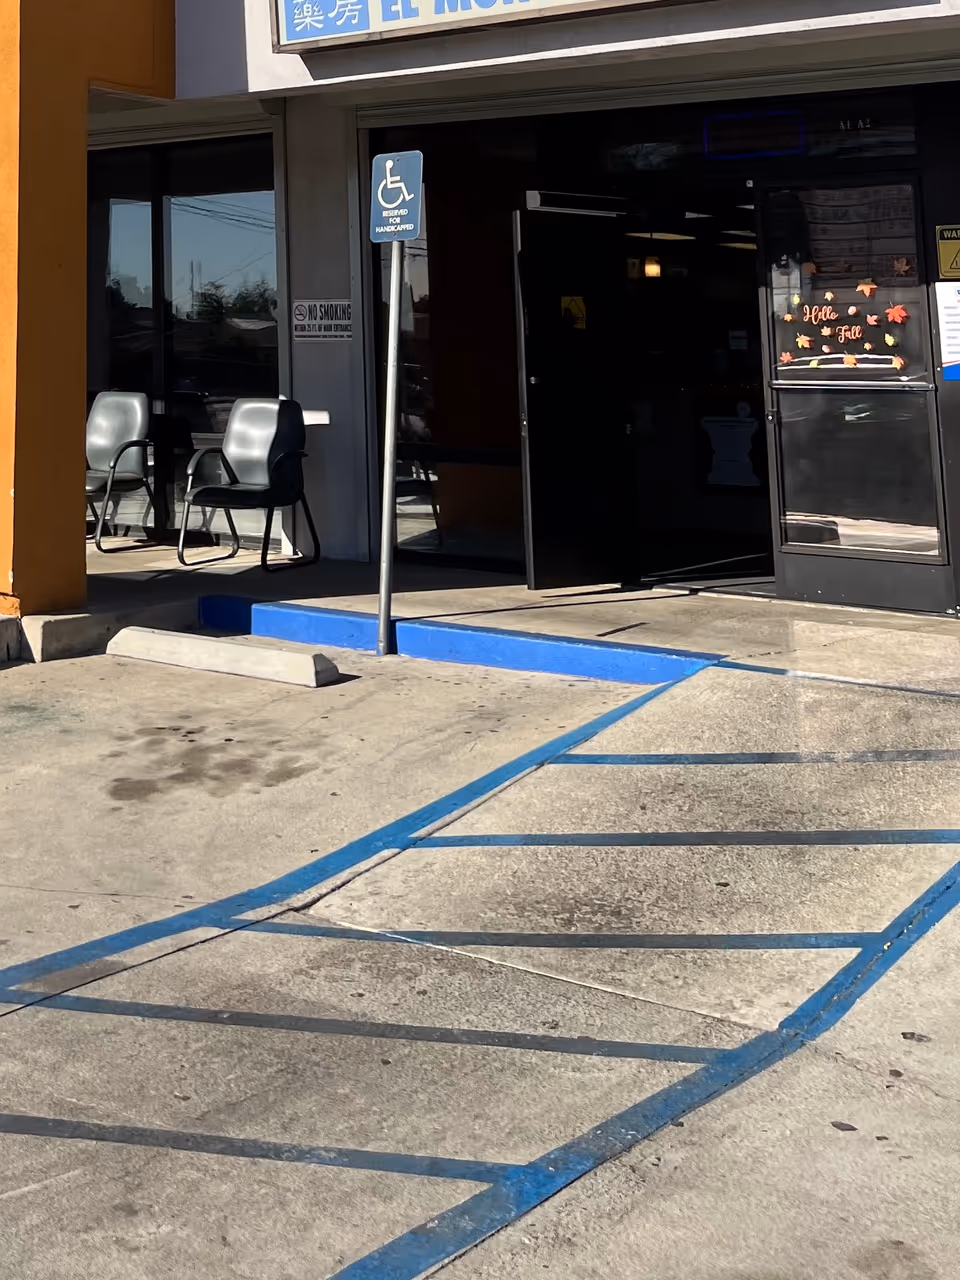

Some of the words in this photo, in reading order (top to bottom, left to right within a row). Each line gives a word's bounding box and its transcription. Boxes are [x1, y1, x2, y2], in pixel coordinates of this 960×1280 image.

[382, 208, 409, 217] RESERVED
[375, 223, 414, 233] HANDICAPPED
[307, 303, 318, 321] NO
[319, 303, 352, 321] SMOKING
[803, 305, 839, 324] Hello
[836, 325, 862, 343] Fall
